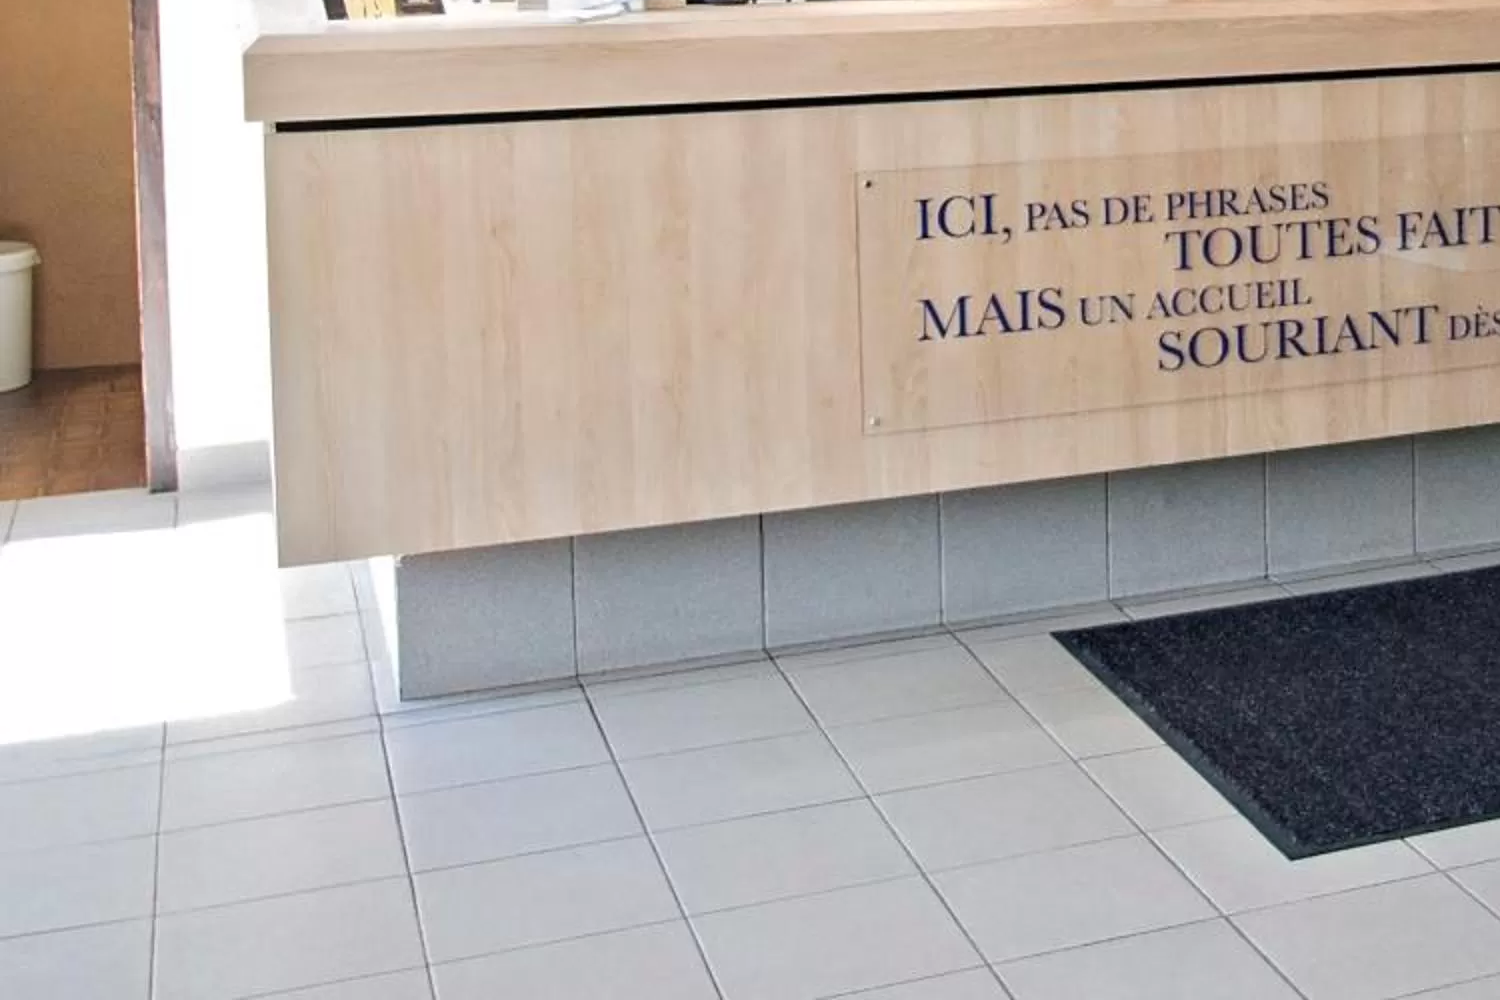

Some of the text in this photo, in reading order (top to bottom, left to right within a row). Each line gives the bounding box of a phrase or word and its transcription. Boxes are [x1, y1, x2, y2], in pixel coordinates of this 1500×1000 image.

[914, 181, 1331, 244] ICI, PAS DE PHRASES
[1164, 215, 1381, 271] TOUTES
[917, 277, 1312, 342] MAIS UN ACCUEIL
[1156, 303, 1440, 372] SOURIANT
